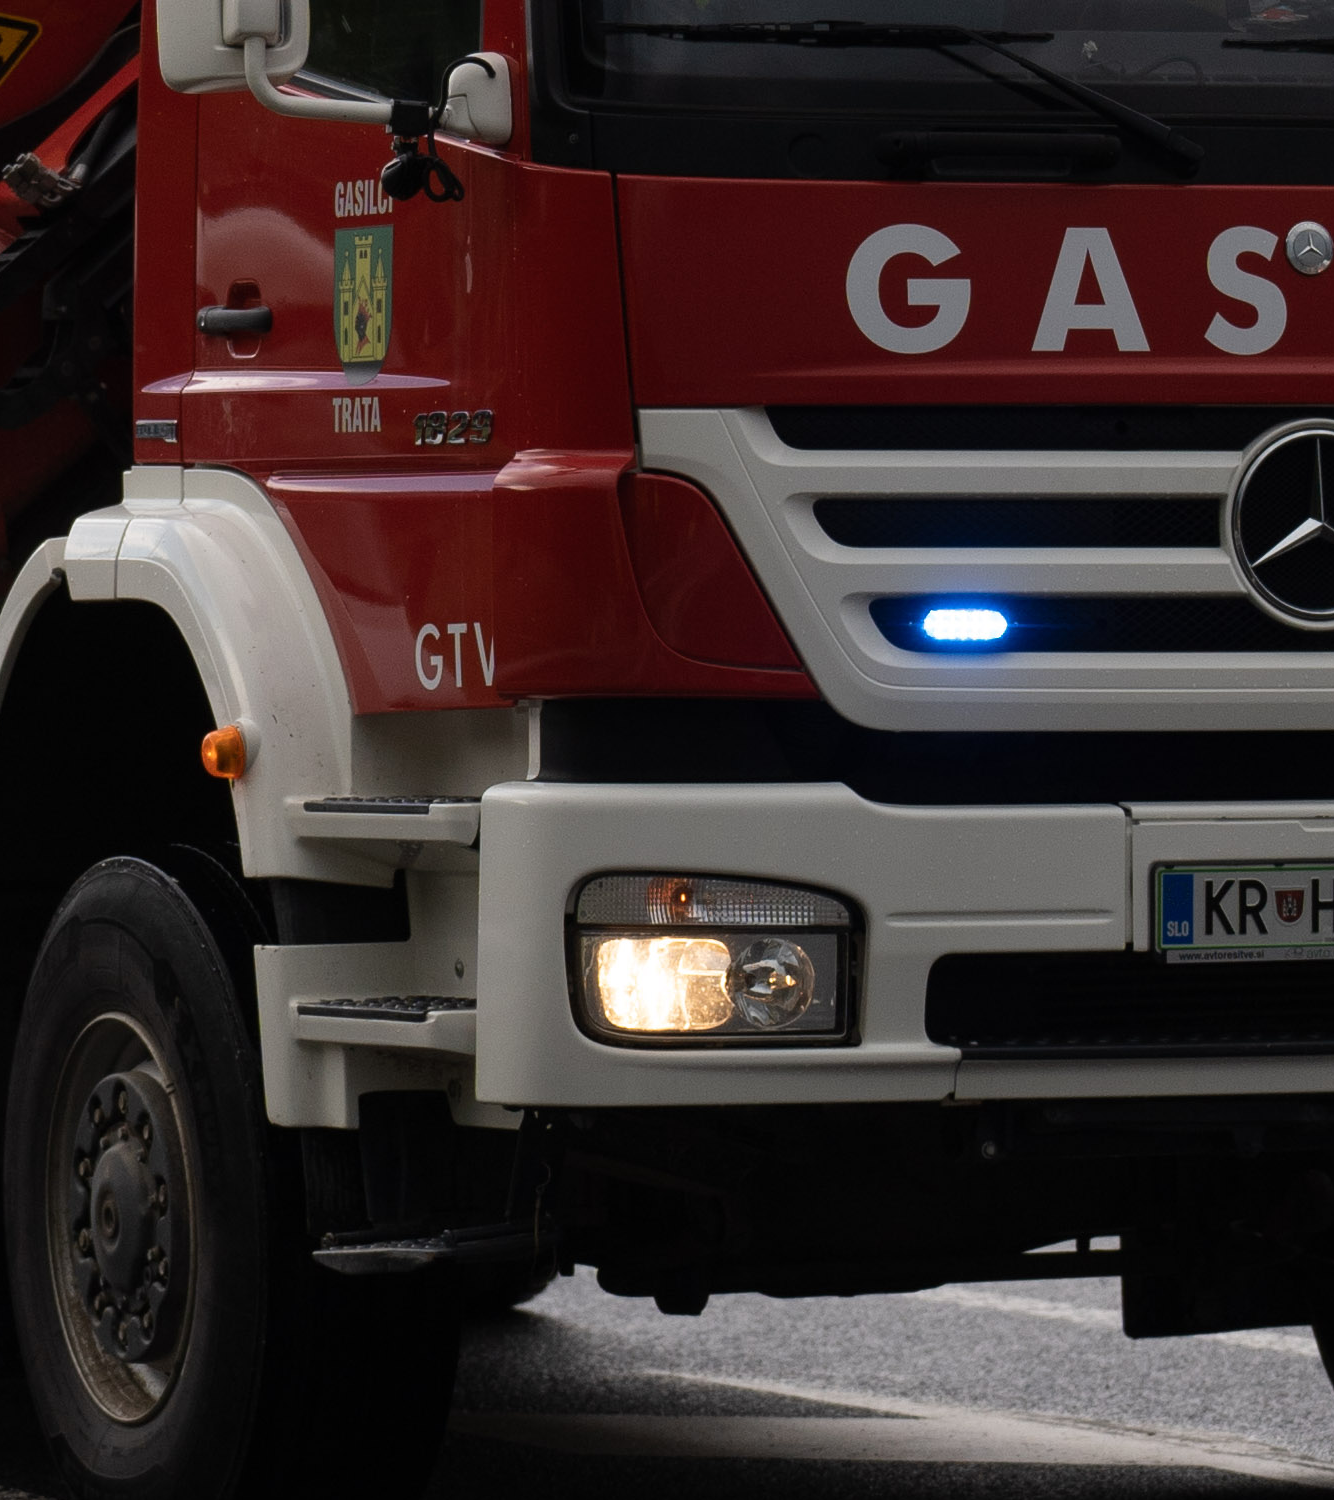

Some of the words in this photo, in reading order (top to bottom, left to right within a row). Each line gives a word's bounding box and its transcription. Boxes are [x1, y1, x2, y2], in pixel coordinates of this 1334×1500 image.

[332, 396, 382, 433] TRATA
[412, 409, 495, 446] 1829
[415, 622, 495, 691] GTV
[1204, 878, 1269, 937] KR
[1167, 919, 1189, 938] SLO
